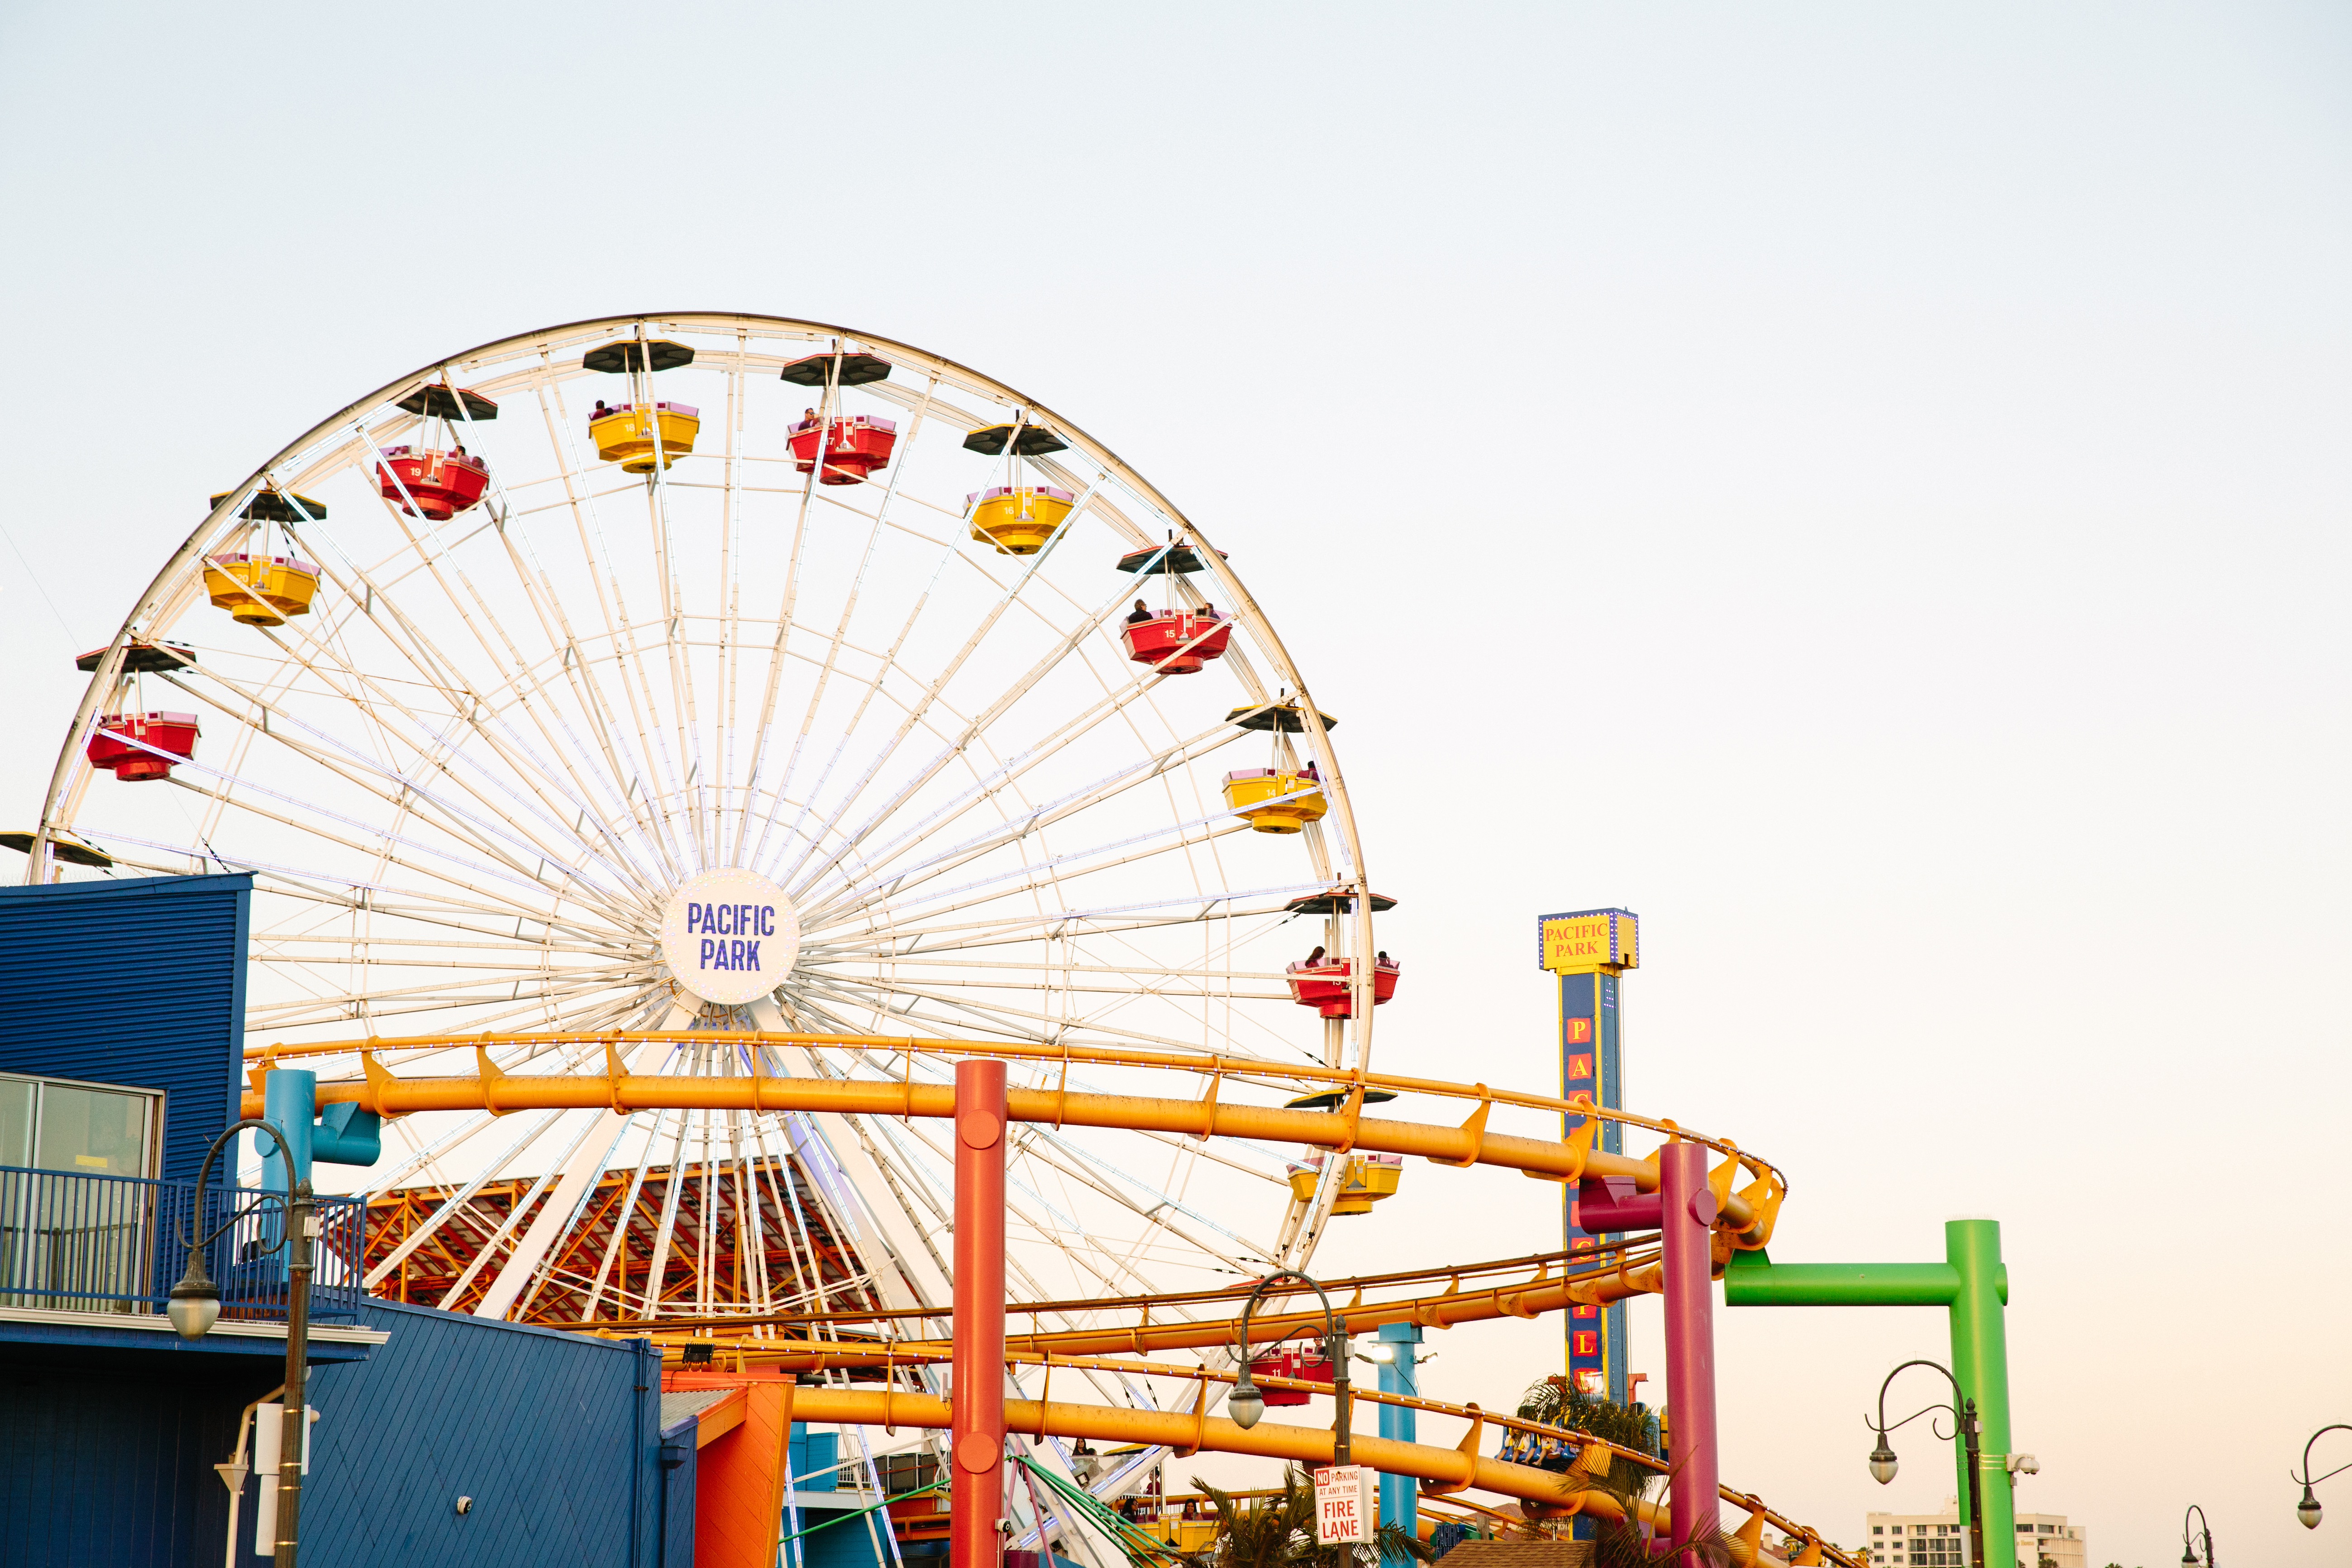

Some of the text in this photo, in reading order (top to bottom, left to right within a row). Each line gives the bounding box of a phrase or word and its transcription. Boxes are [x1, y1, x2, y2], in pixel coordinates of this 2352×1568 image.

[625, 424, 635, 432] 18
[410, 467, 421, 477] 19
[1003, 506, 1014, 515] 16
[237, 573, 249, 583] 20
[1164, 630, 1175, 638] 15
[687, 902, 775, 936] PACIFIC
[1545, 923, 1608, 942] PACIFIC
[700, 939, 761, 971] PARK
[1555, 941, 1599, 957] PARK
[1317, 1471, 1358, 1485] NO PARKING
[1328, 1487, 1340, 1495] ANY
[1342, 1485, 1358, 1493] TIME
[1324, 1500, 1355, 1519] FIRE
[1322, 1520, 1359, 1539] LANE
